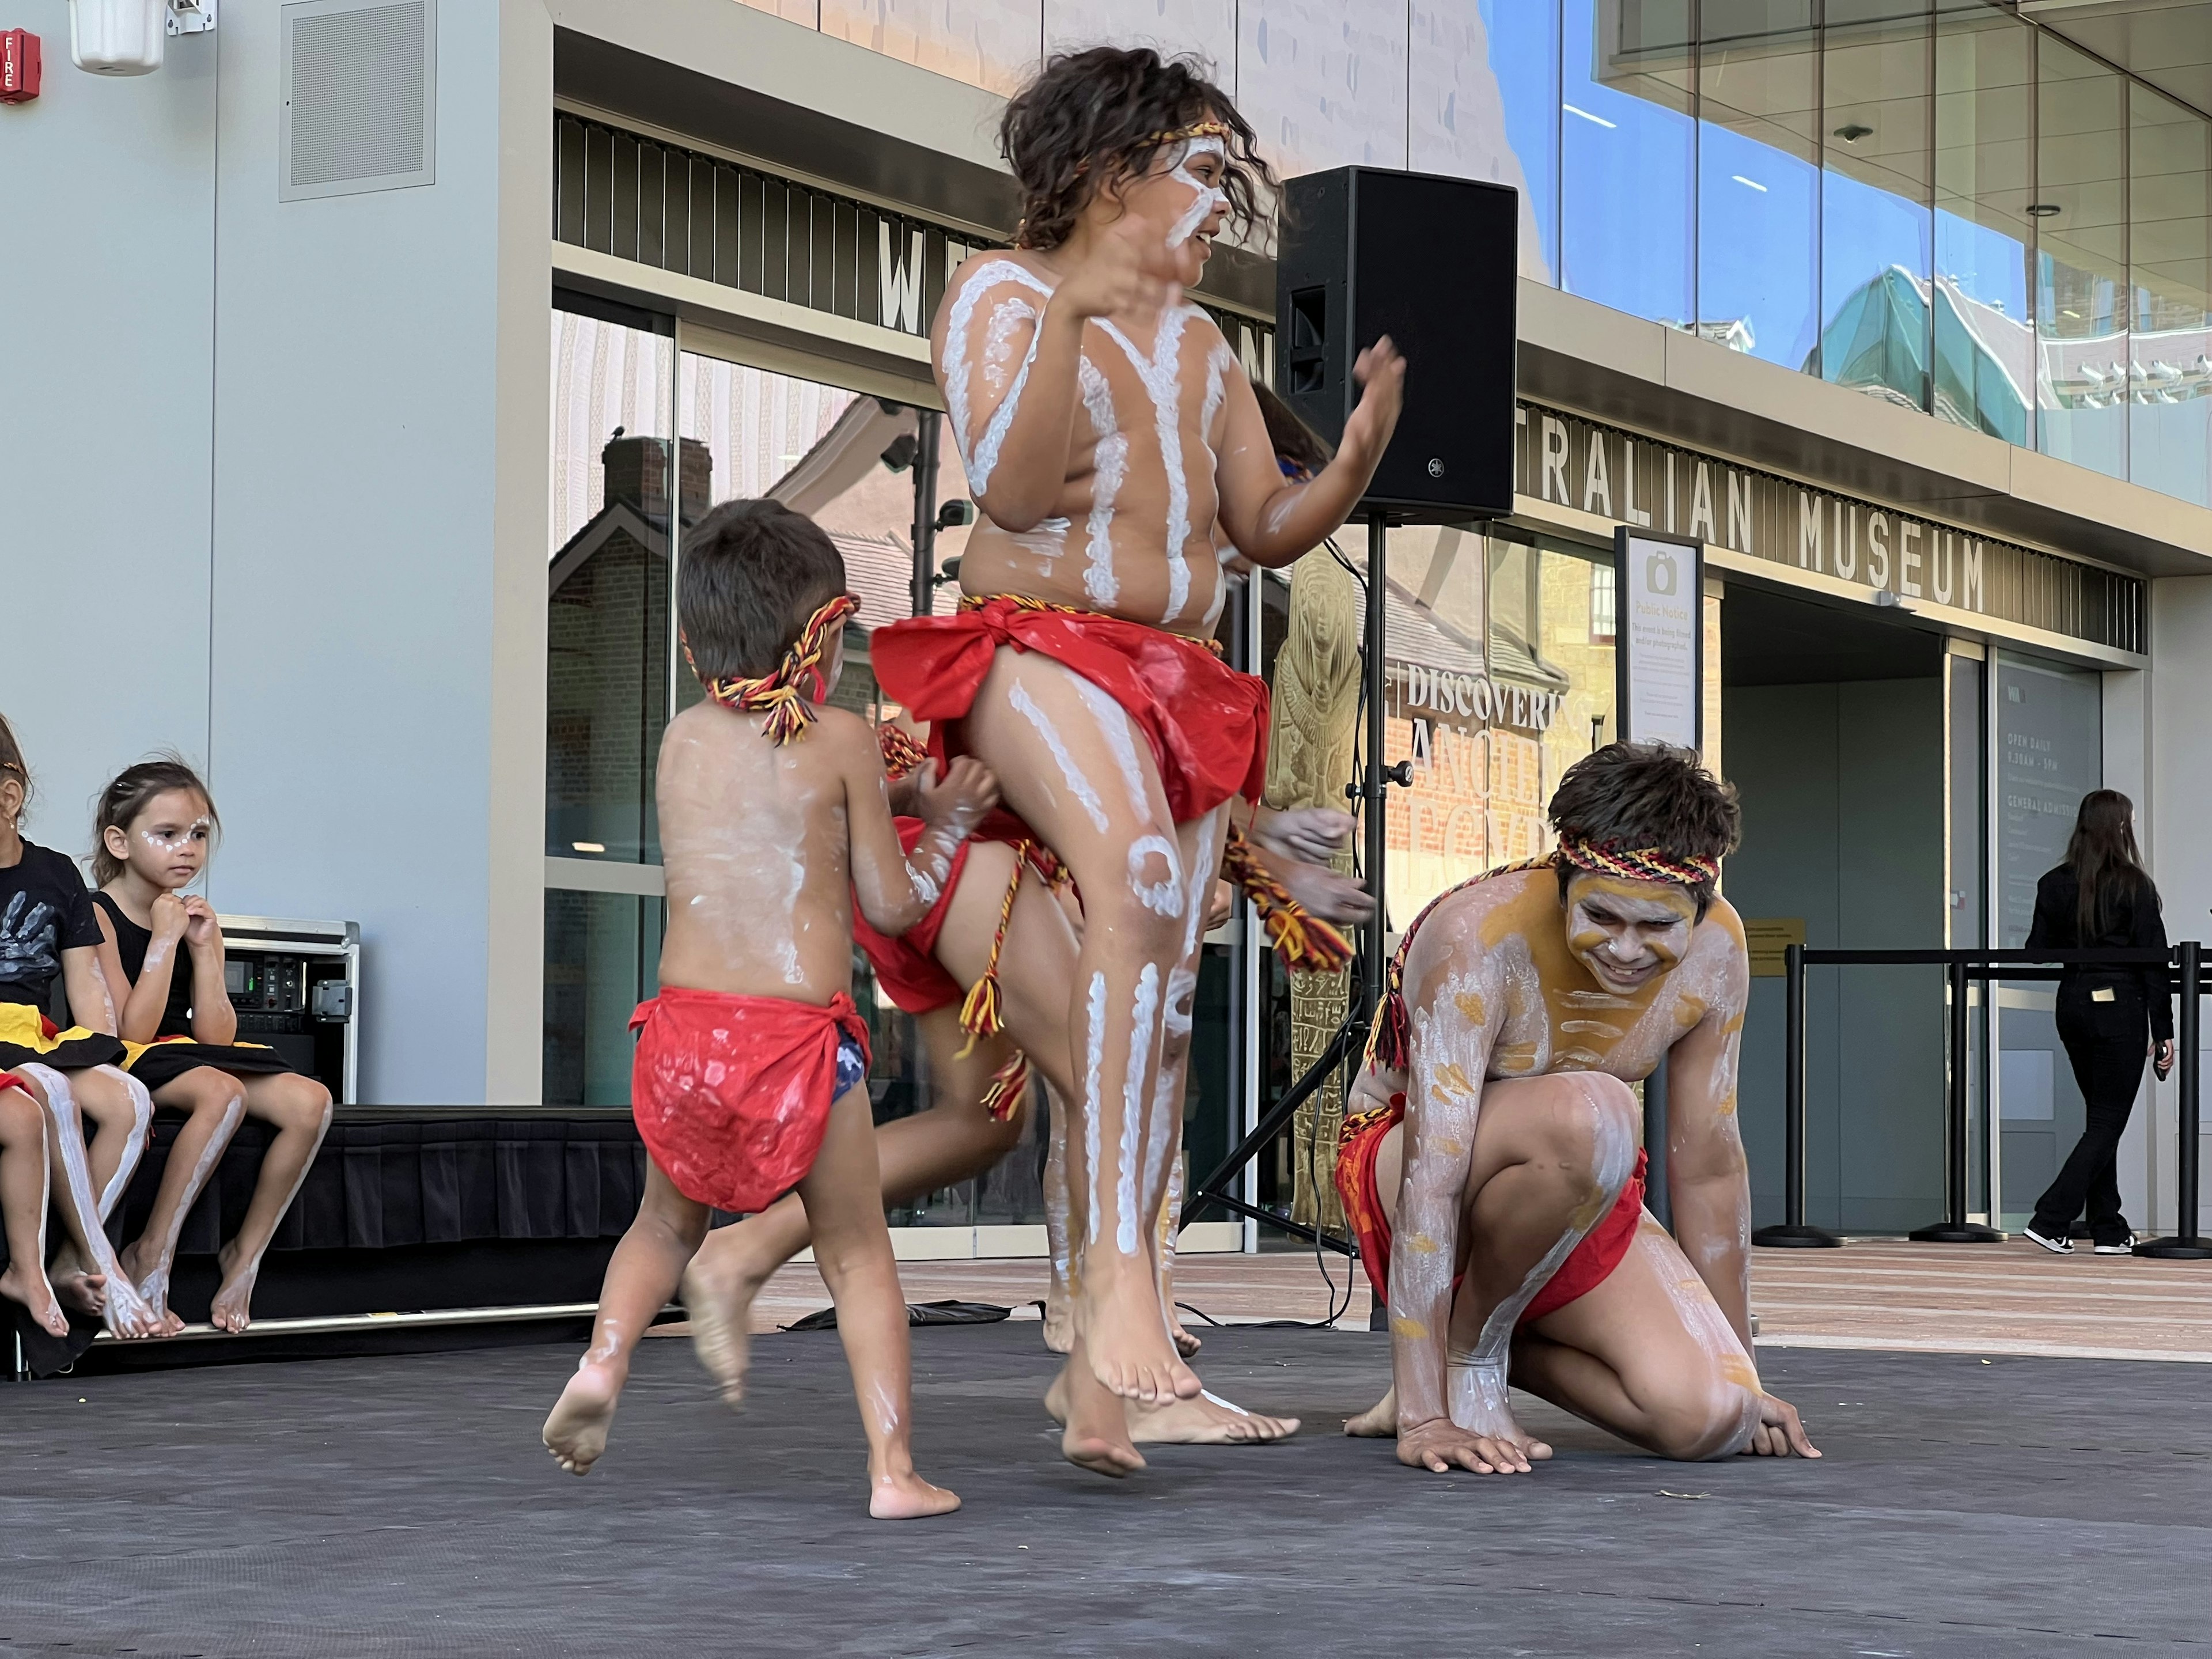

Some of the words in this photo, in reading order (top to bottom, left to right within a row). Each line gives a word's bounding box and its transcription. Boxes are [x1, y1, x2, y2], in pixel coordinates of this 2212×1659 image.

[5, 37, 14, 87] FIRE
[1801, 491, 1983, 613] MUSEUM
[1635, 600, 1661, 616] Public
[1662, 604, 1688, 621] Notice
[2008, 733, 2028, 747] OPEN
[2030, 737, 2051, 752] DAILY
[2008, 795, 2041, 812] GENERAL
[2043, 801, 2078, 818] ADMISSIO
